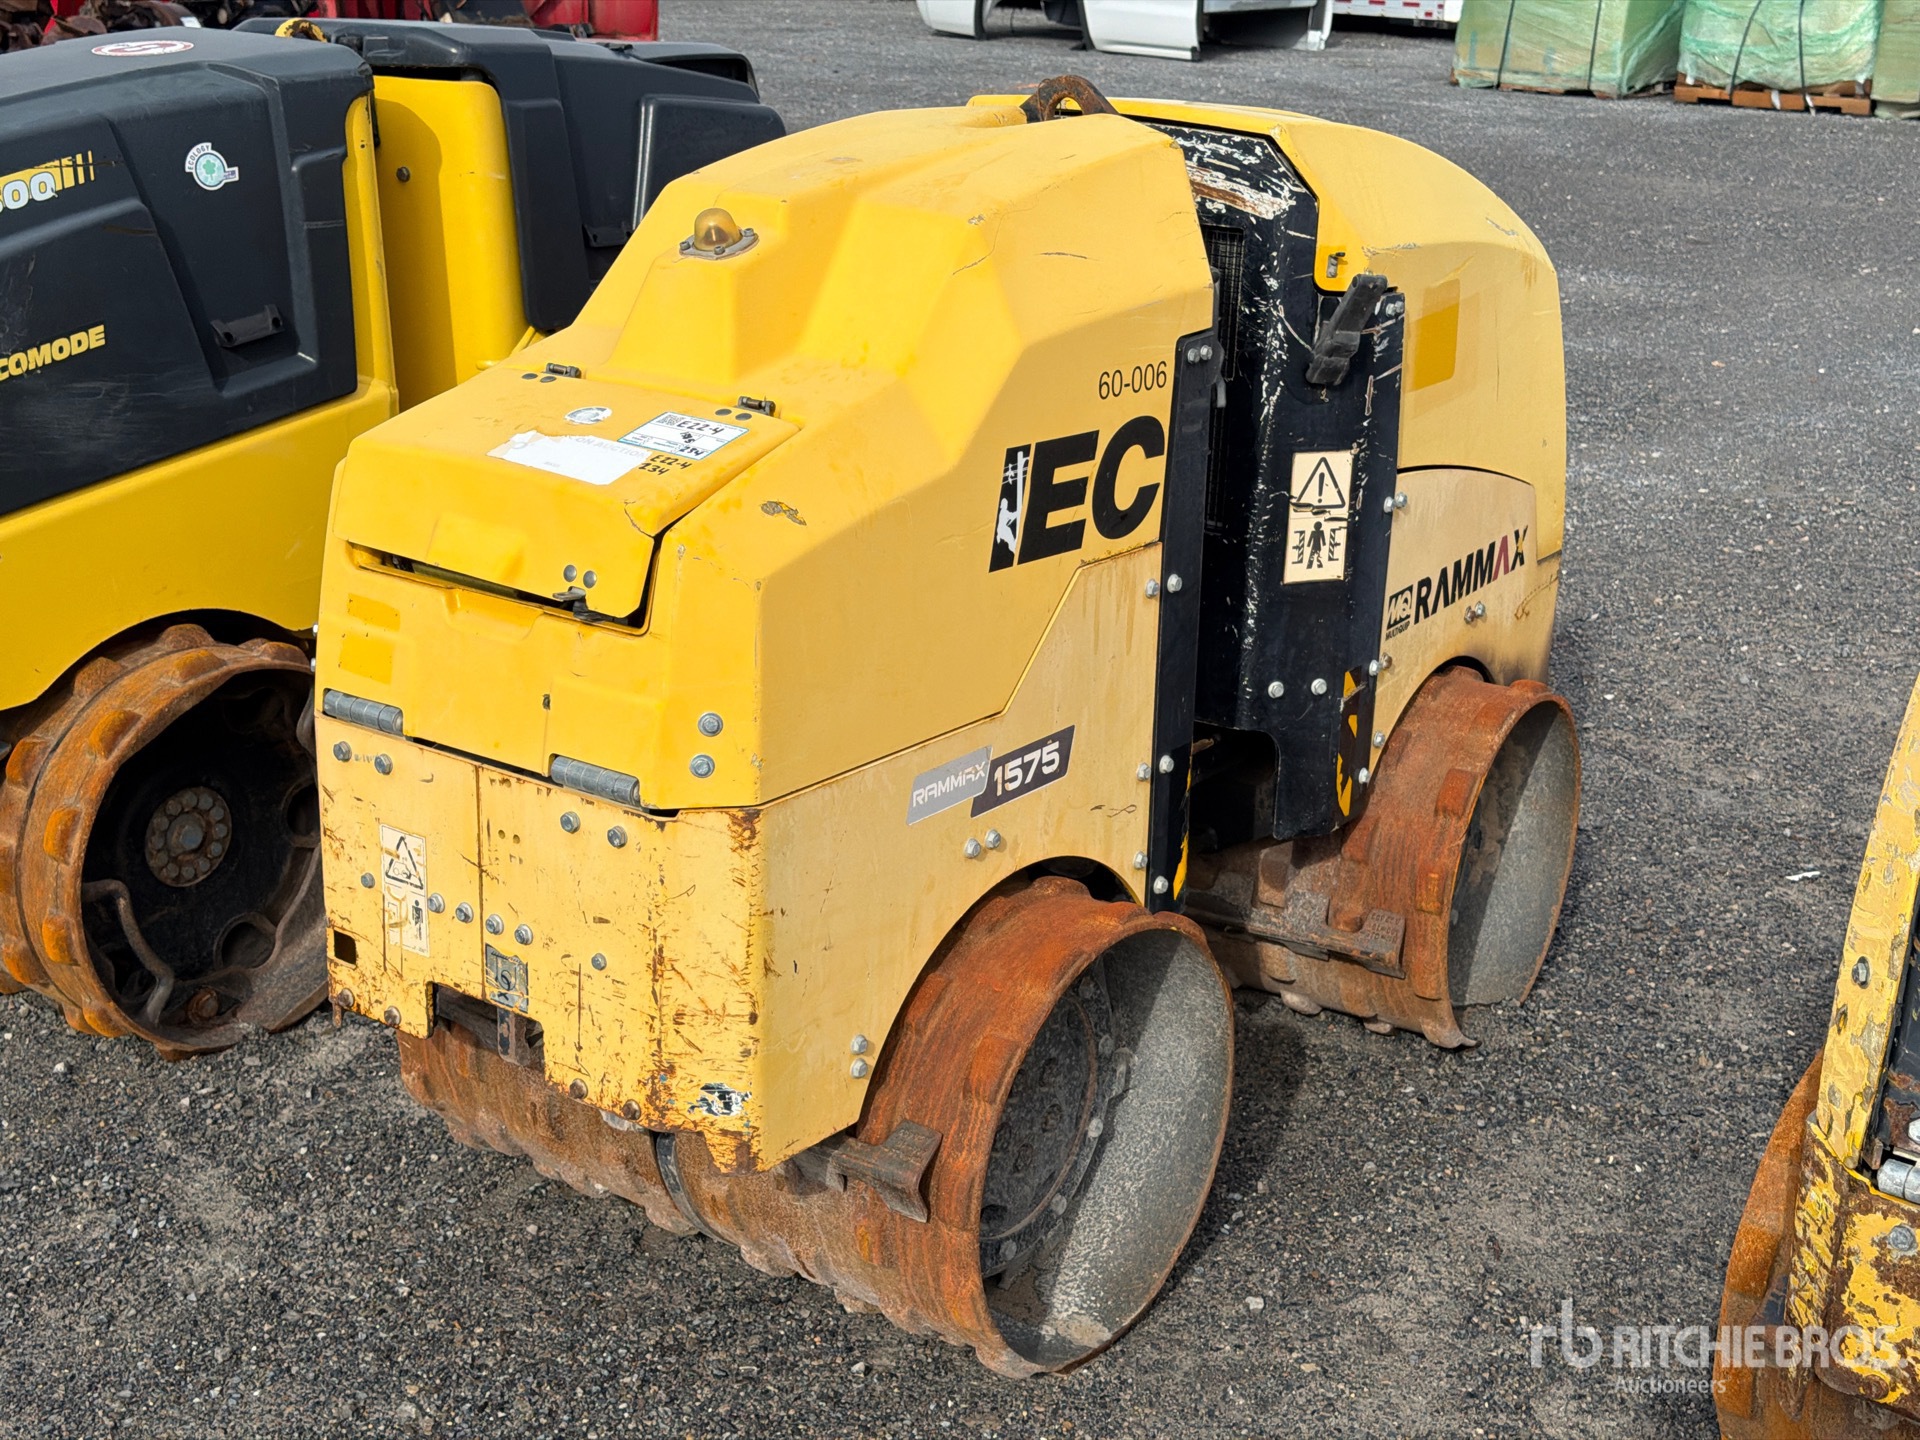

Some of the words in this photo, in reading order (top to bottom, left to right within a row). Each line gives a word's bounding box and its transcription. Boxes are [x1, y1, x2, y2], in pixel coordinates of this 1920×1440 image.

[187, 144, 210, 171] ECOLOGY
[1098, 360, 1168, 400] 60-006
[1414, 525, 1528, 624] RAMMAX
[911, 760, 986, 808] RAMMAX
[994, 740, 1060, 797] 1575
